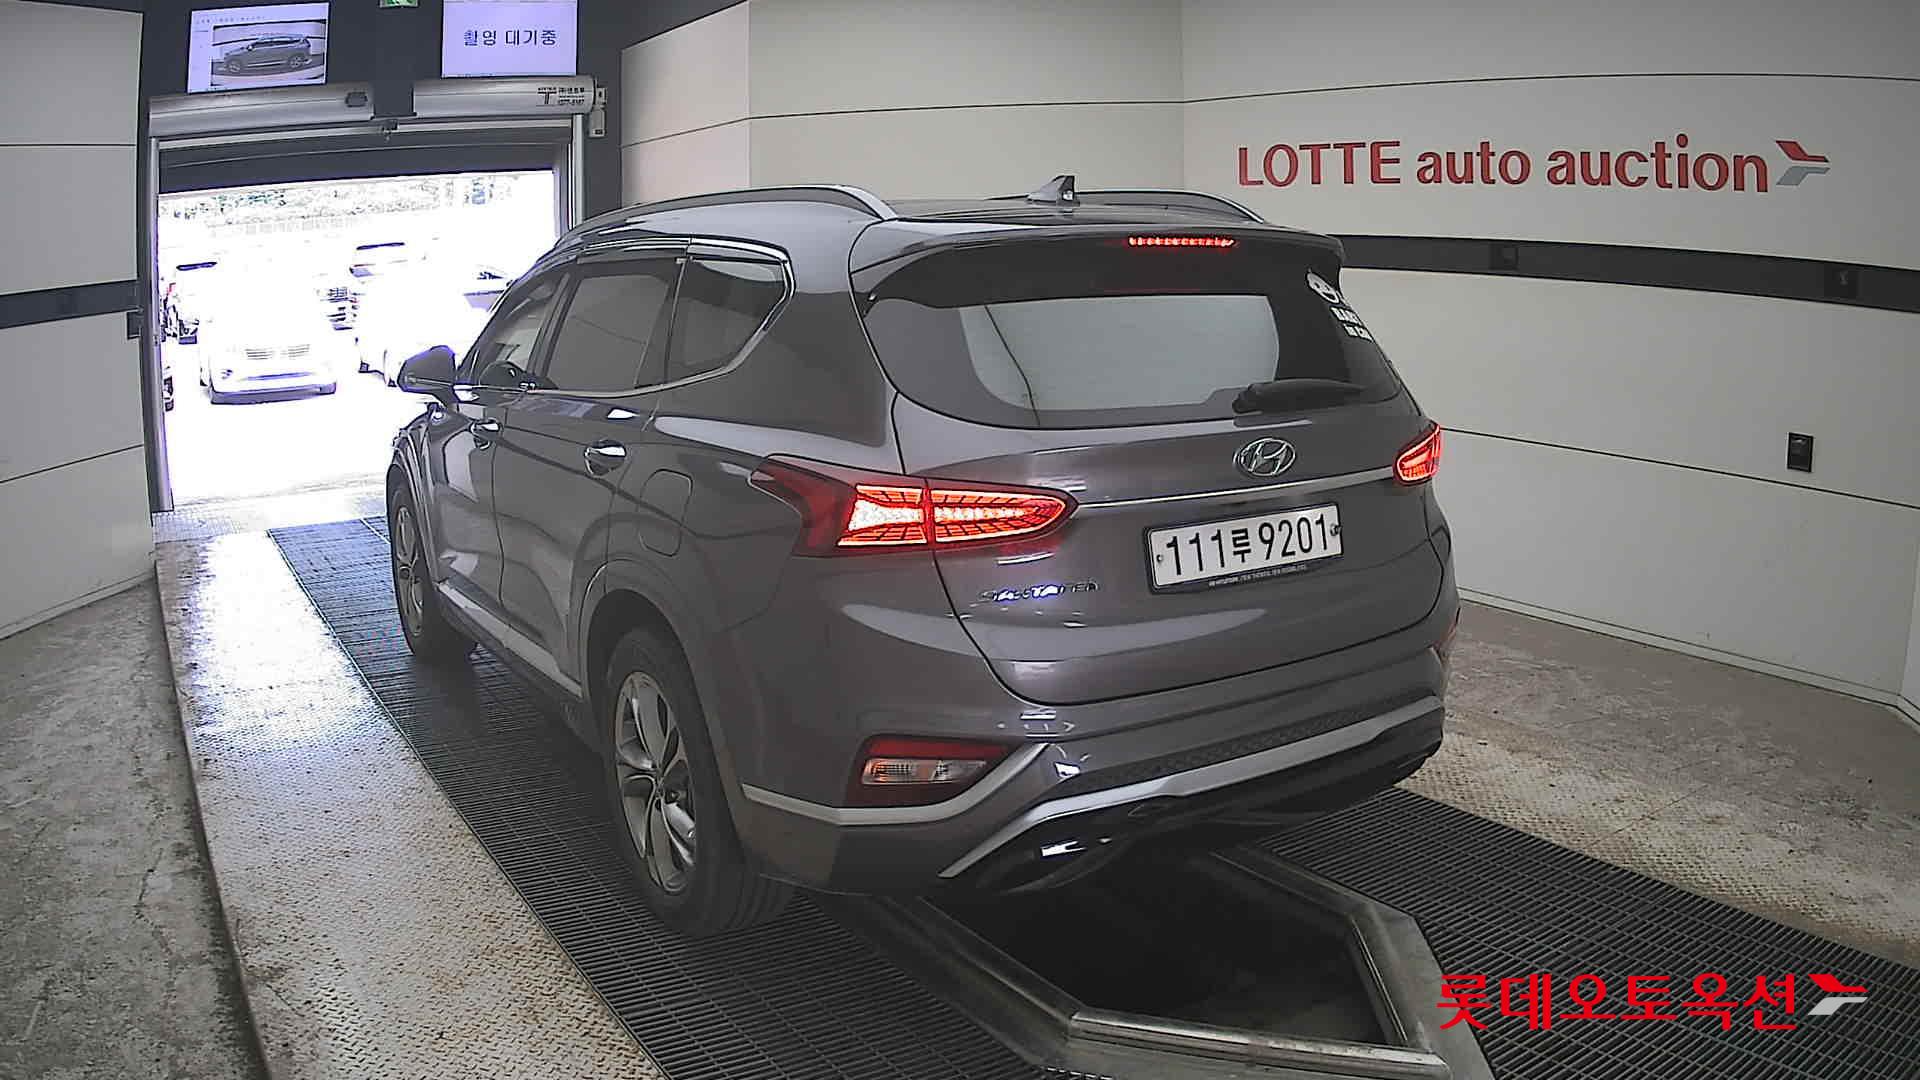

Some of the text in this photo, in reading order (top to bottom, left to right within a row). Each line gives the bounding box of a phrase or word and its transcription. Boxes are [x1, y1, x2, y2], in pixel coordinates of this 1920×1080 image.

[505, 29, 557, 46] 대기중
[1239, 133, 1769, 193] LOTTE auto auction
